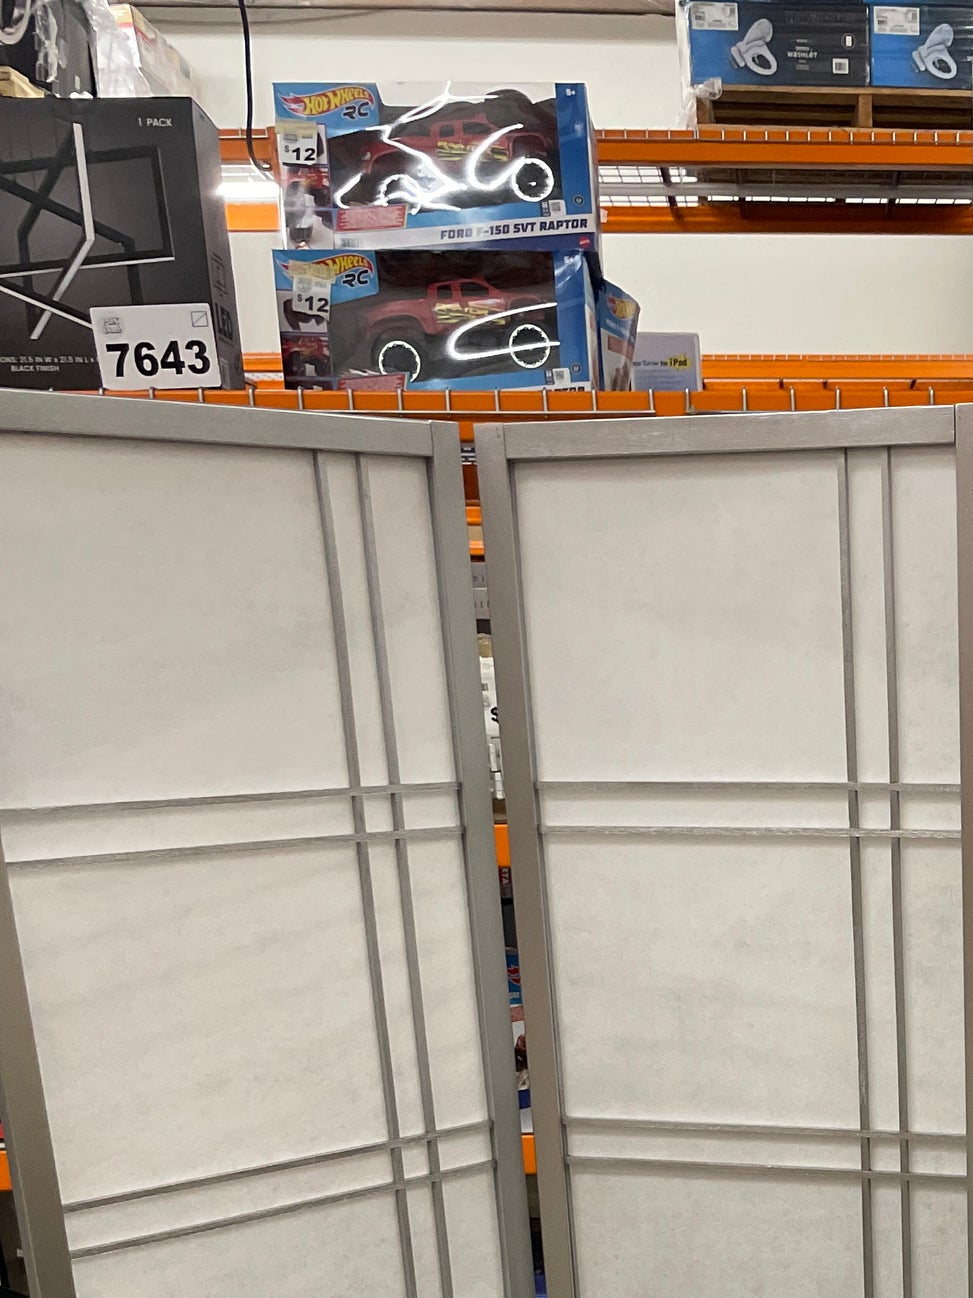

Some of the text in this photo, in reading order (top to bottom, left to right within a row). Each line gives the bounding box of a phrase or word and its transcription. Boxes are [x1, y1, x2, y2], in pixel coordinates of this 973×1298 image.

[342, 102, 369, 120] RC
[137, 117, 173, 127] 1 PACK
[440, 228, 473, 240] FORD
[513, 221, 537, 234] SVT
[539, 218, 588, 232] RAPTOR
[342, 269, 369, 287] RC
[105, 340, 211, 378] 7643
